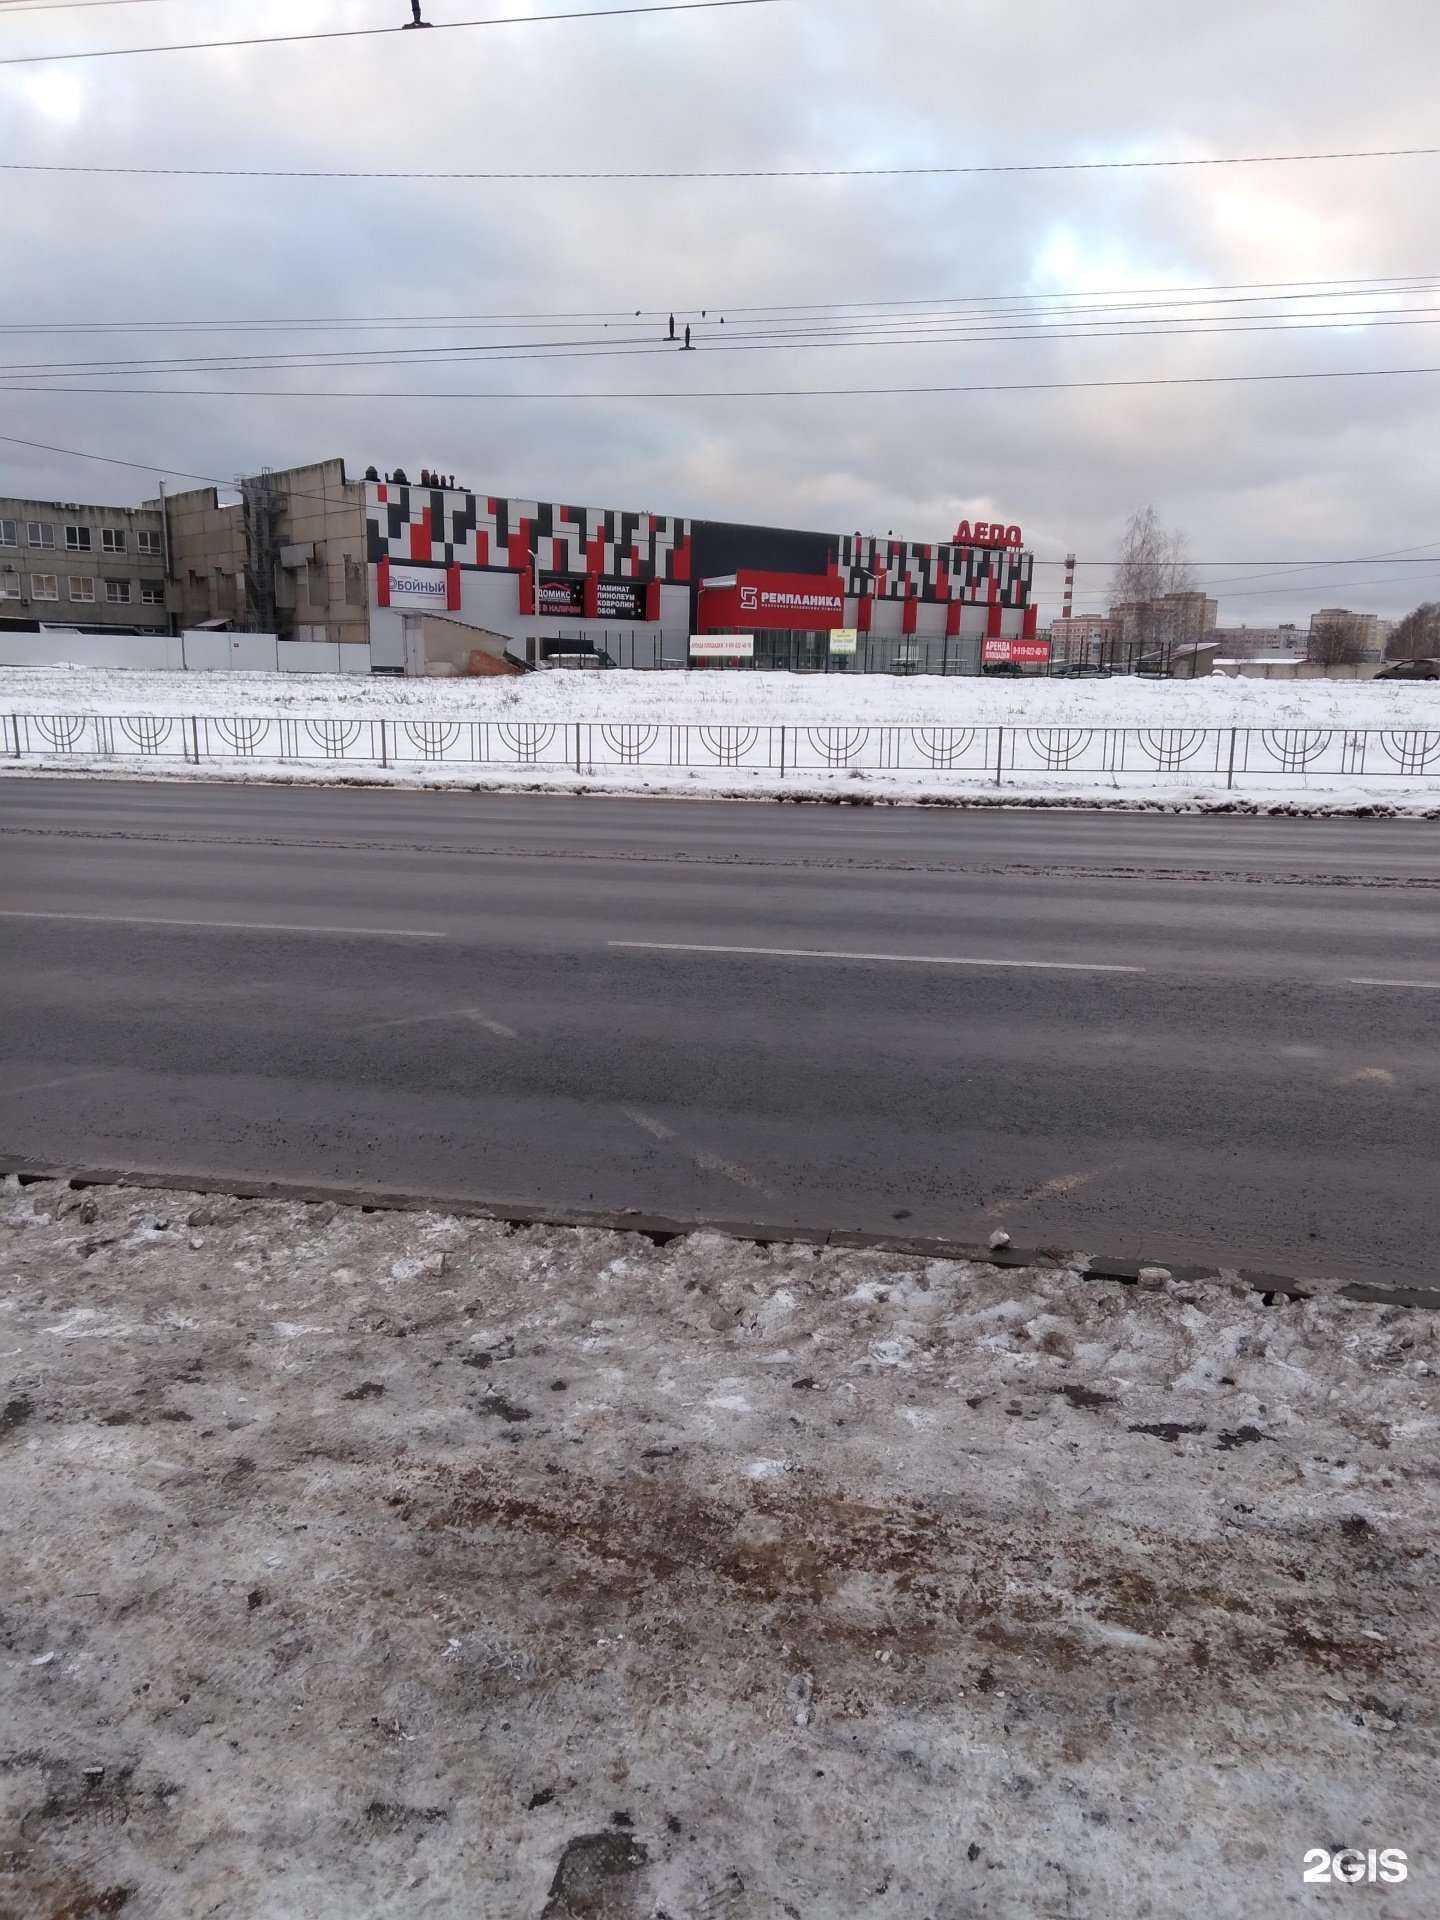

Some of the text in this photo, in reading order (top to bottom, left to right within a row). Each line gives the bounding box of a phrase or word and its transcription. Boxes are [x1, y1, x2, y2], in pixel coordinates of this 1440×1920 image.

[954, 520, 1022, 546] ДЕПО
[761, 592, 841, 607] РЕМПЛАНИКА
[986, 641, 1010, 652] АРЕНДА
